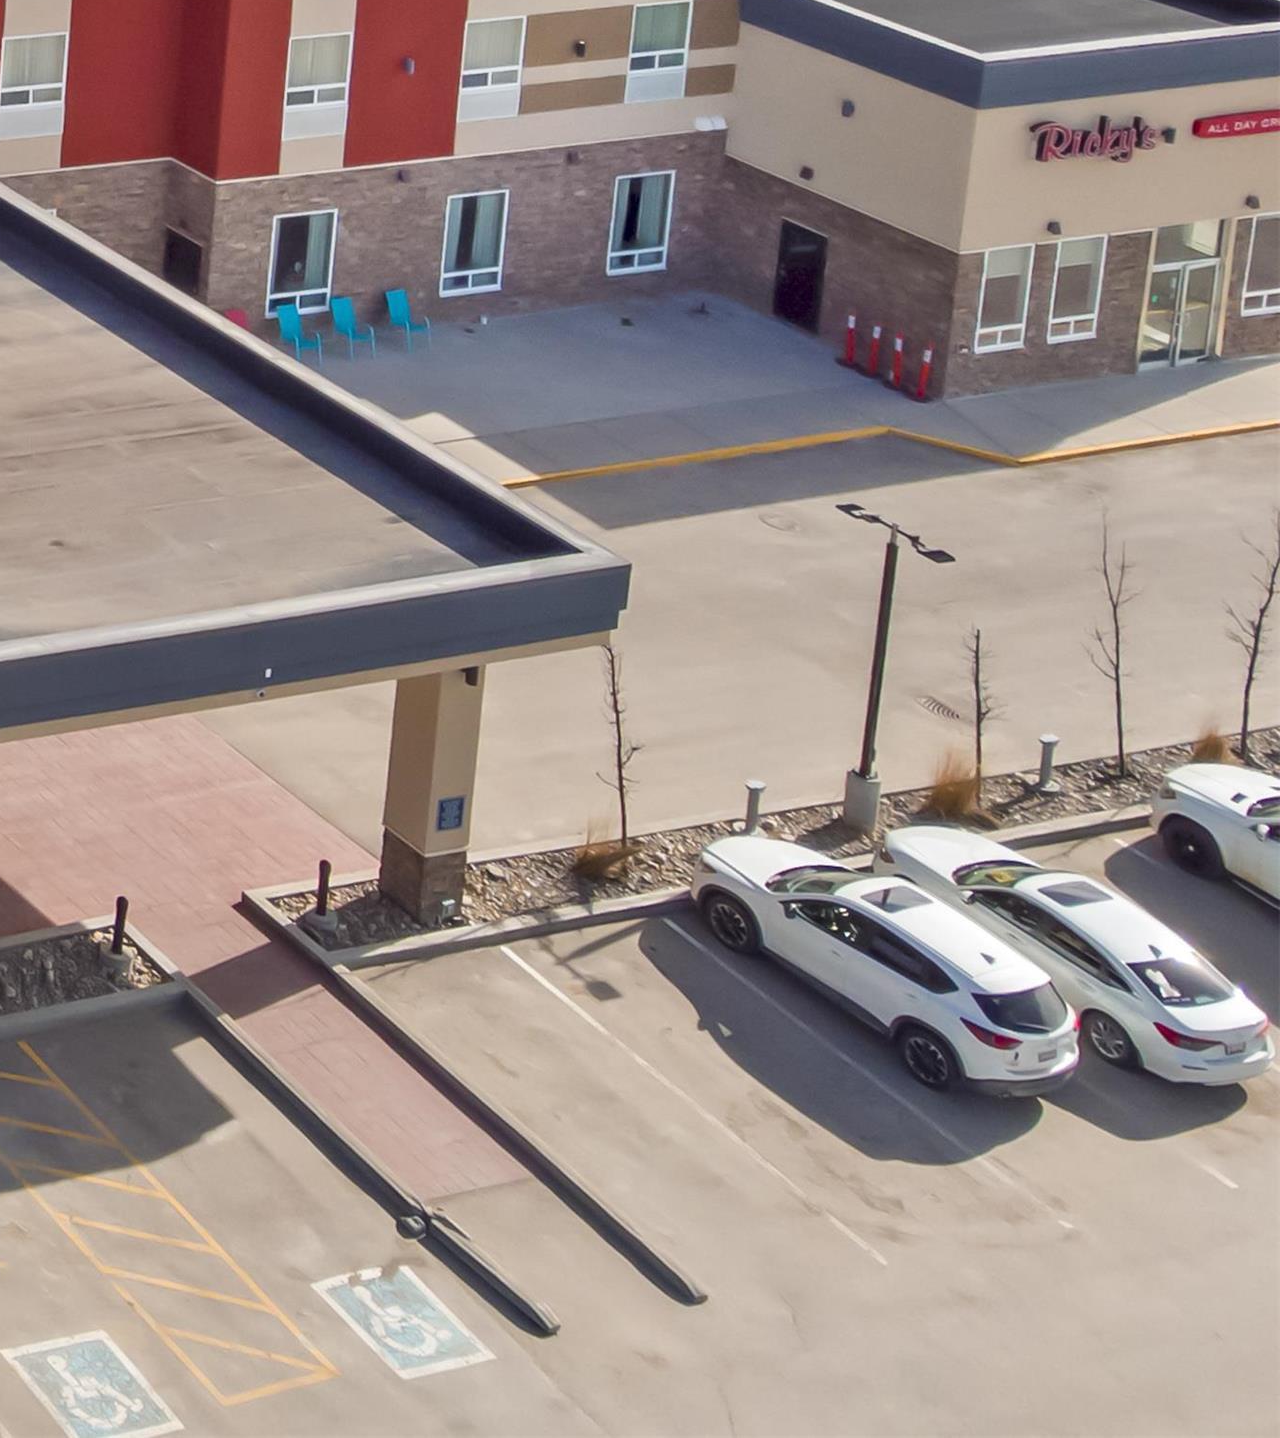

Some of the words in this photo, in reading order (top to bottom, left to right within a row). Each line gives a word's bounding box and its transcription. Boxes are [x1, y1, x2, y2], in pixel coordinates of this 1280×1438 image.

[1030, 115, 1157, 163] Ricky's
[1207, 123, 1230, 134] ALL
[1233, 120, 1258, 131] DAY
